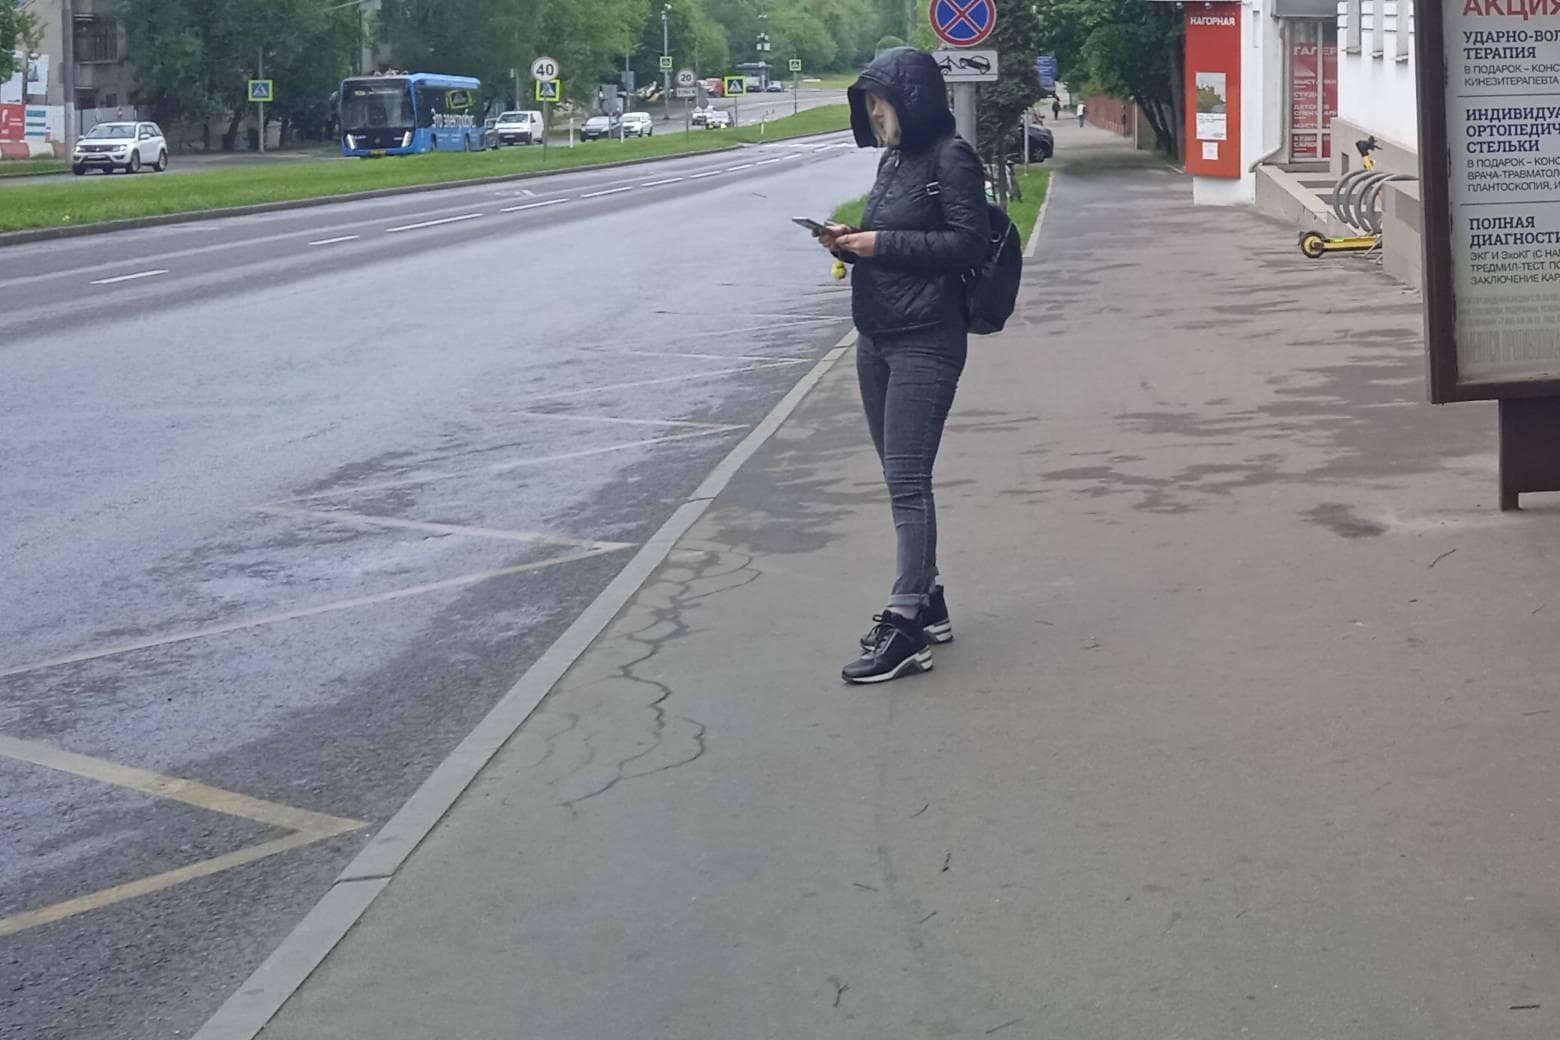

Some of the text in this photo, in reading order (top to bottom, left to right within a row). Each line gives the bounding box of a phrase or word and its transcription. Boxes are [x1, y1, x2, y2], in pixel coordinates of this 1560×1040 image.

[1190, 16, 1236, 26] НАГОРНАЯ
[1463, 47, 1536, 60] ТЕРАПИЯ
[536, 64, 554, 77] 40
[1464, 65, 1471, 74] В
[1473, 64, 1522, 75] ПОДАРОК
[680, 73, 692, 82] 20
[1464, 76, 1559, 87] КИНЕЗИТЕРАПЕВТА
[1467, 139, 1540, 154] СТЕЛЬКИ
[1467, 159, 1474, 168] В
[1477, 157, 1524, 169] ПОДАРОК
[1469, 216, 1535, 231] ПОЛНАЯ
[1470, 251, 1488, 261] ЭКГ
[1491, 251, 1499, 260] И
[1471, 273, 1539, 285] ЗАКЛЮЧЕНИЕ
